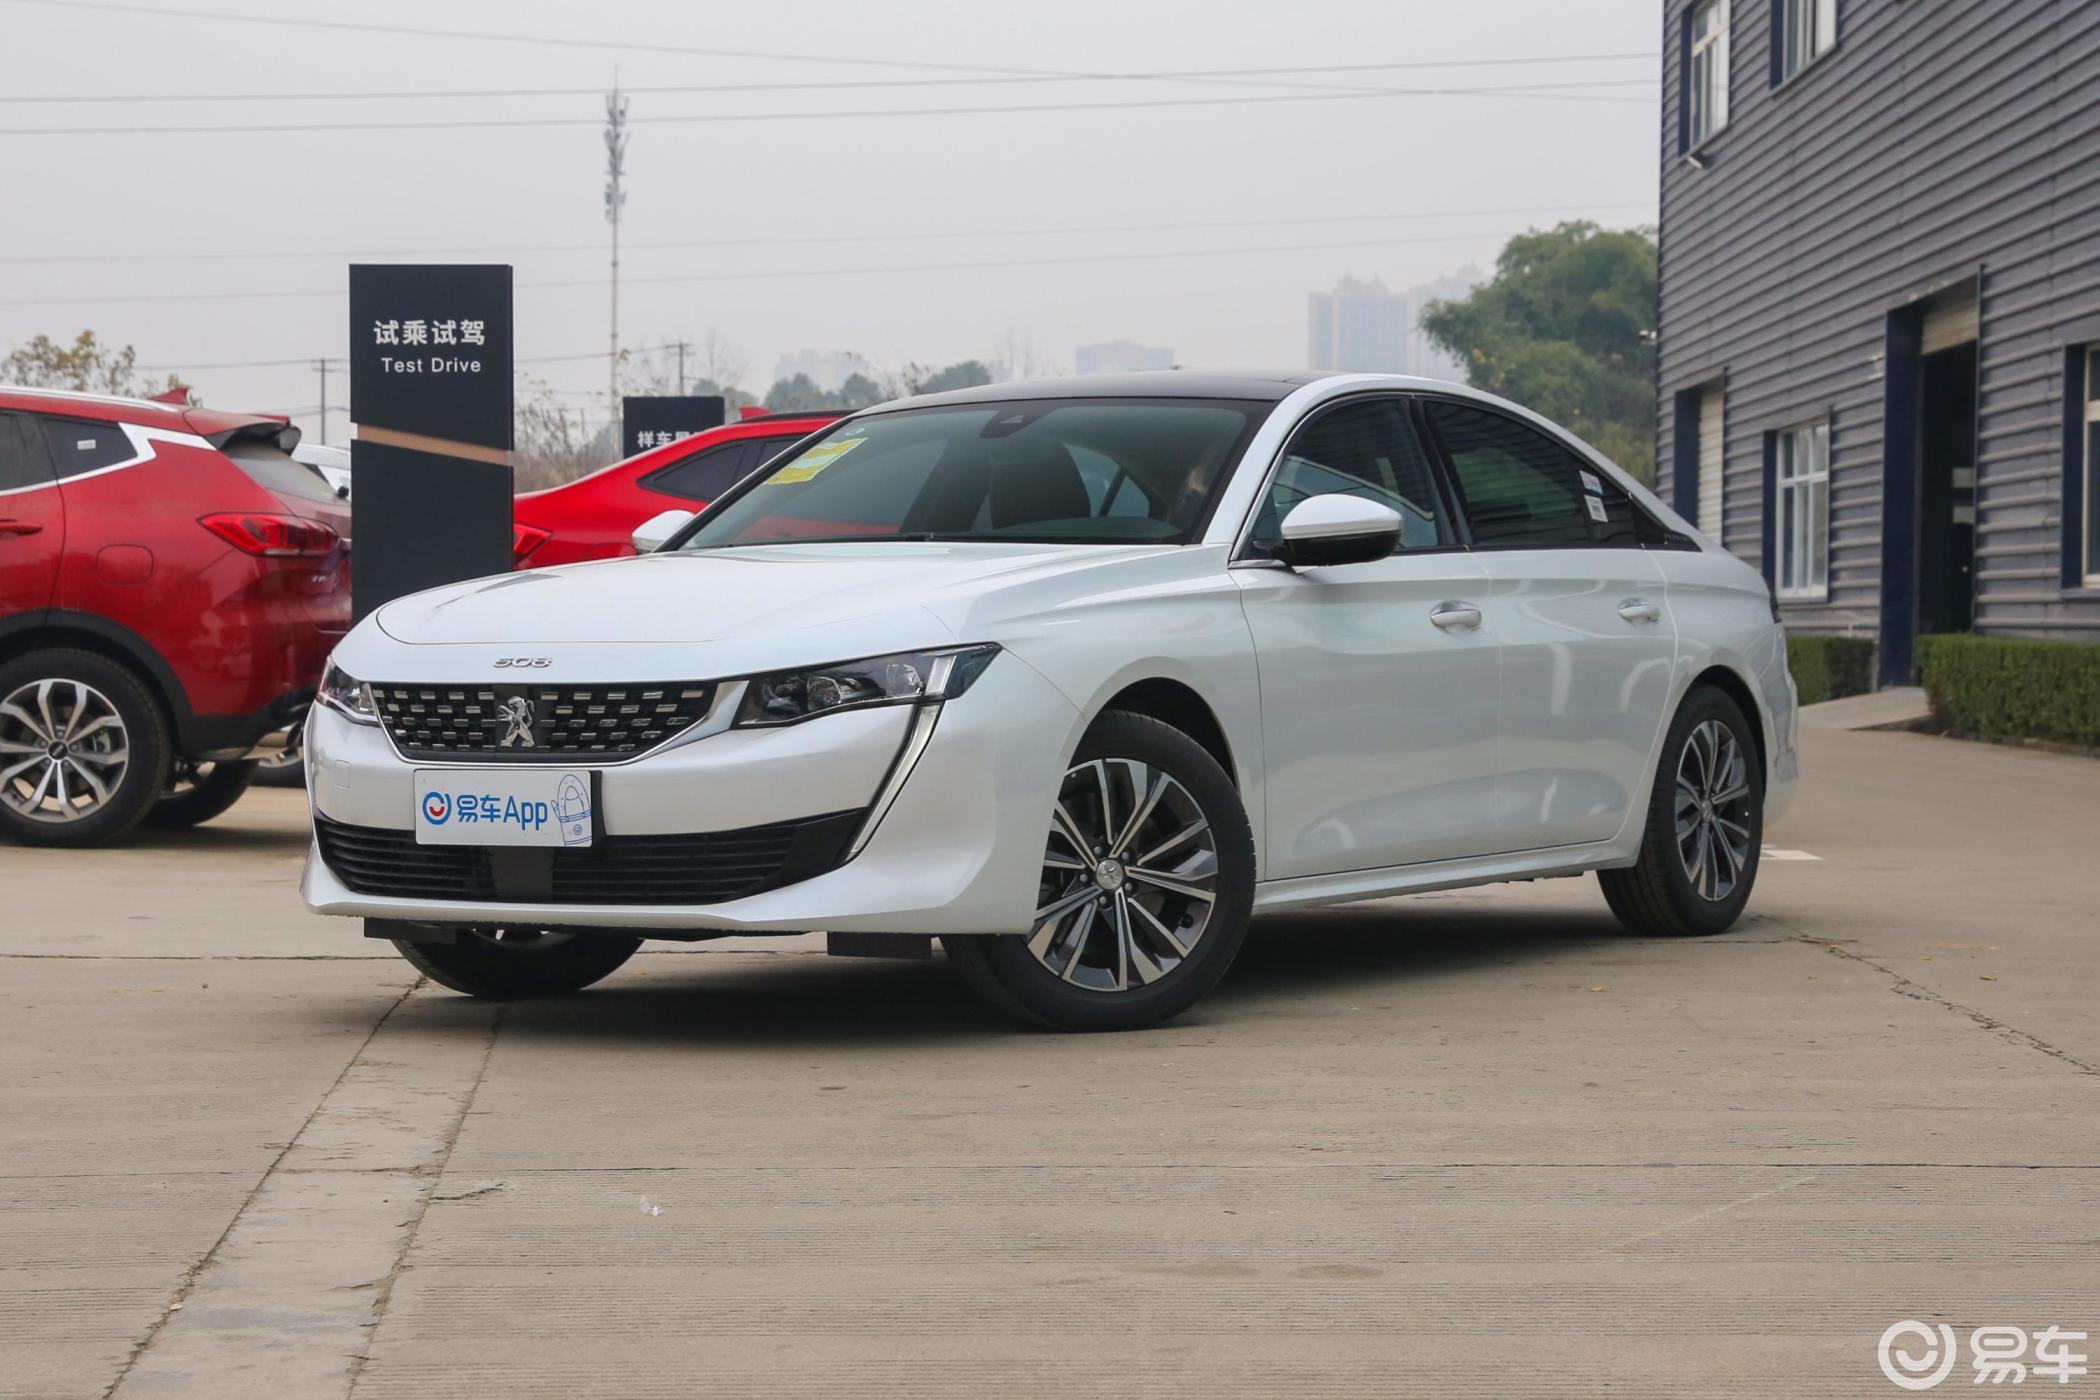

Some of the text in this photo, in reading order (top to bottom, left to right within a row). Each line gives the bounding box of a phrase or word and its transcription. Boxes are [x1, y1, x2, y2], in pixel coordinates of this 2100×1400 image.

[373, 319, 485, 346] 试乘试驾
[381, 357, 482, 373] Test Drive
[494, 657, 552, 668] 508
[456, 794, 548, 830] 易车App
